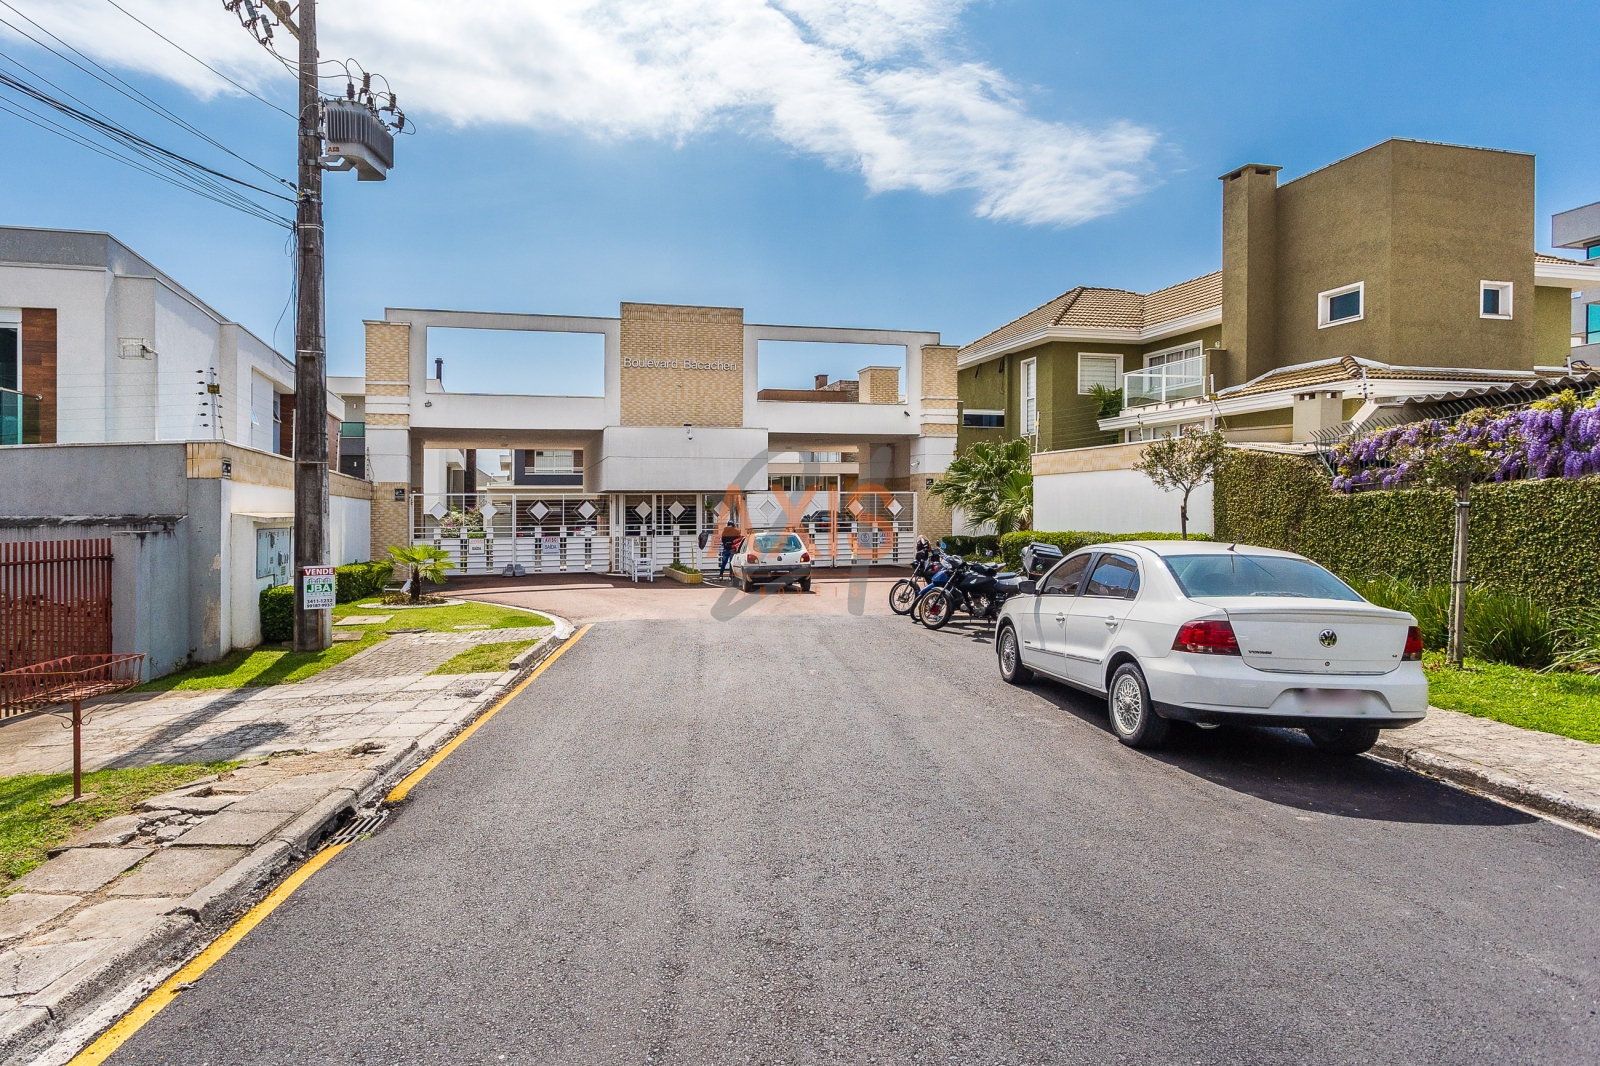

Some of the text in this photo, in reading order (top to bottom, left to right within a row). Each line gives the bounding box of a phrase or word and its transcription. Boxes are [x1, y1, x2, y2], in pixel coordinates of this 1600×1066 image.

[623, 357, 737, 371] Boulevard Bacacheri
[305, 568, 334, 576] VENDE
[307, 584, 332, 592] JBA
